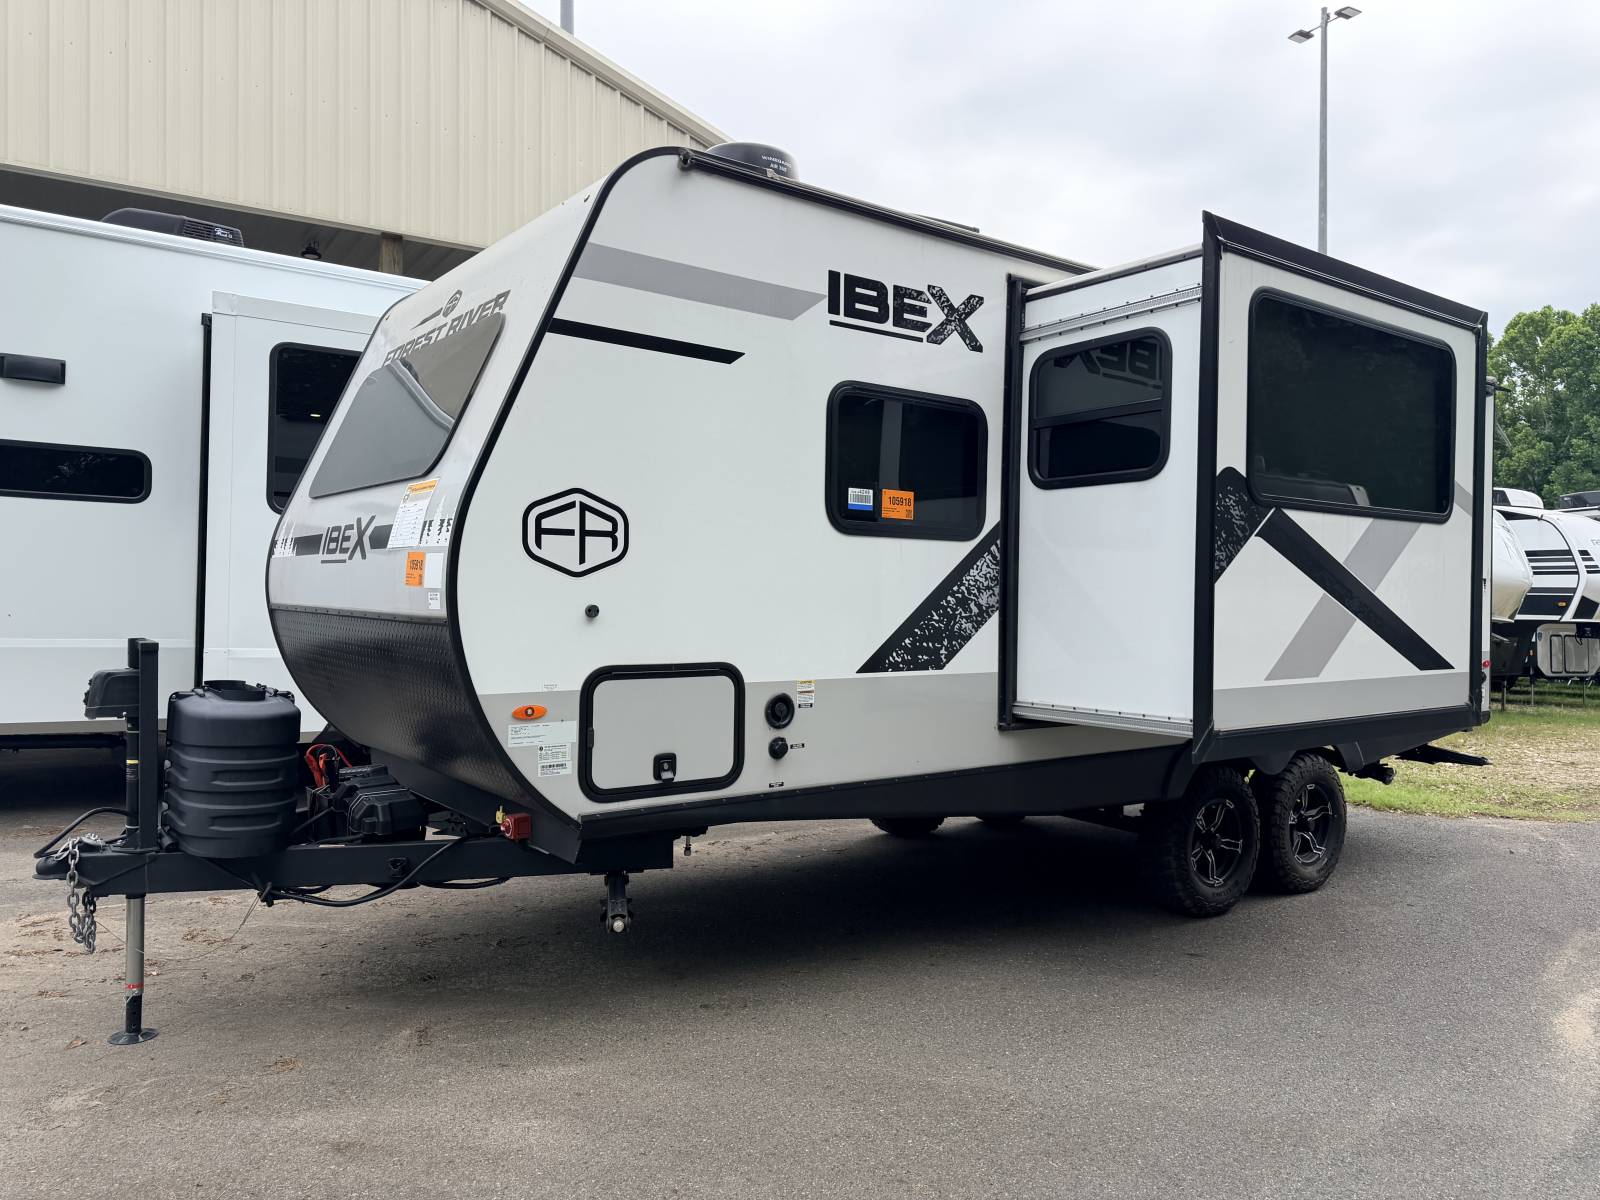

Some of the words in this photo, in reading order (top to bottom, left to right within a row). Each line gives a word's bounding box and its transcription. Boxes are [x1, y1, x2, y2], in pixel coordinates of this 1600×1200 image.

[381, 320, 449, 369] FOREST
[446, 289, 511, 337] RIVER
[828, 269, 985, 353] IBEX
[320, 514, 377, 561] IBEX
